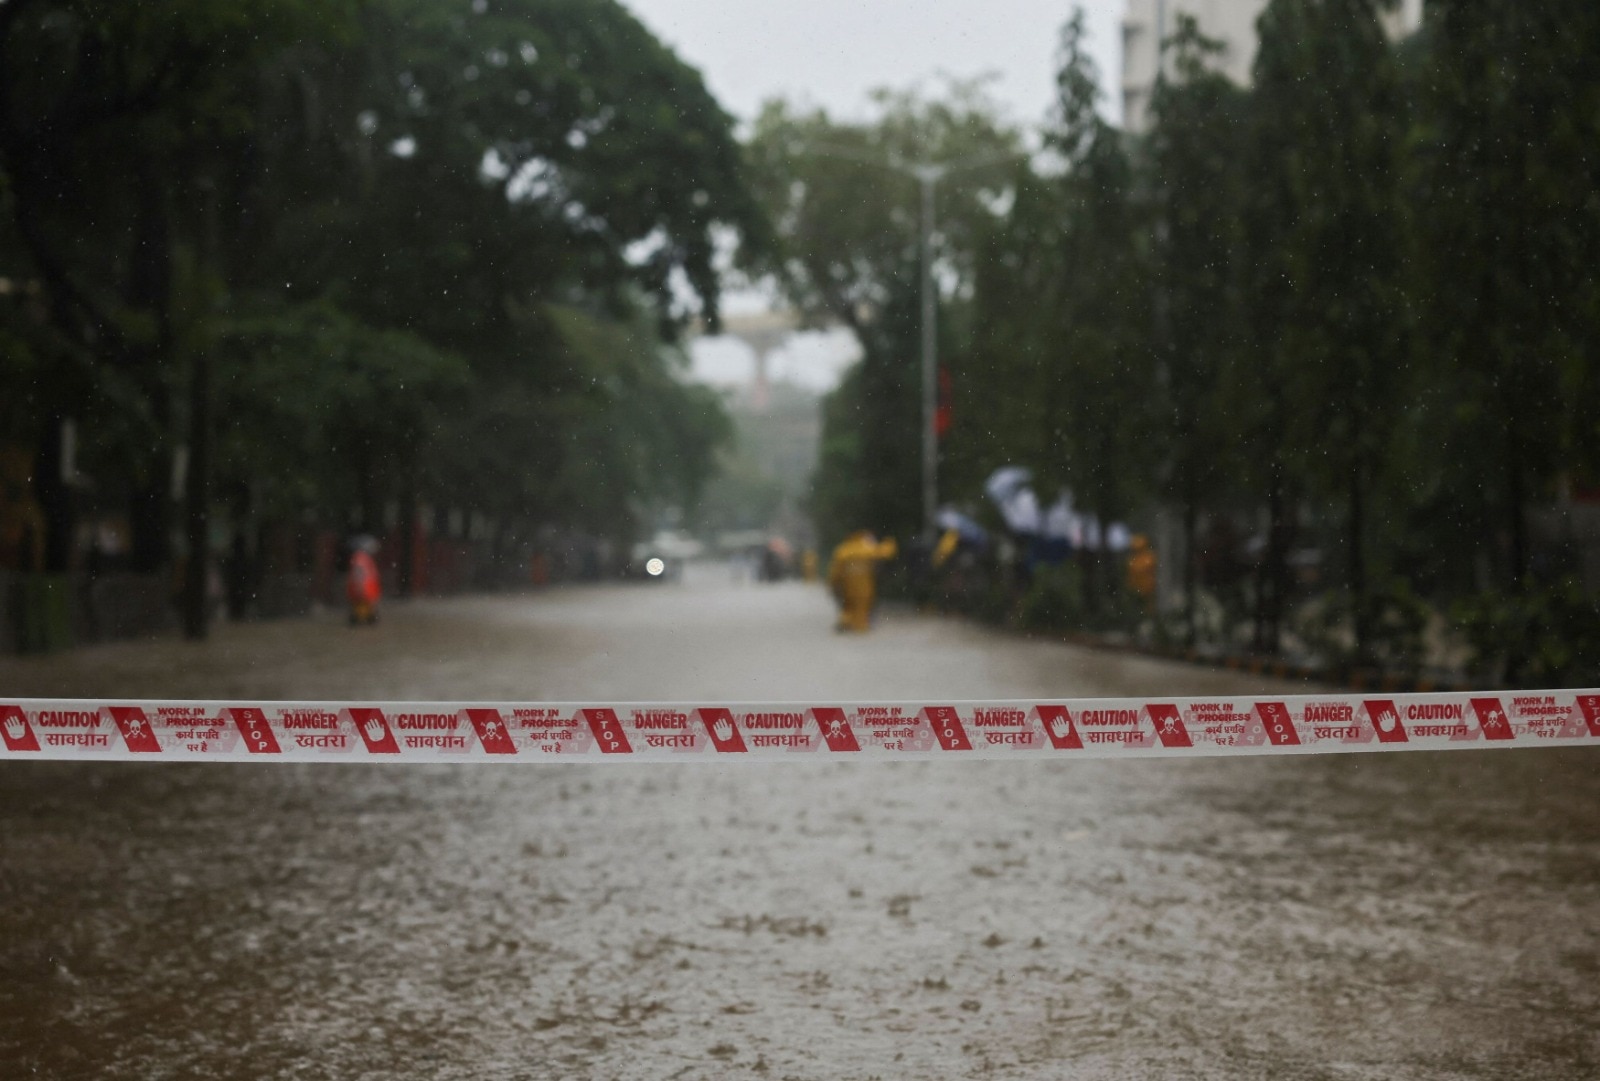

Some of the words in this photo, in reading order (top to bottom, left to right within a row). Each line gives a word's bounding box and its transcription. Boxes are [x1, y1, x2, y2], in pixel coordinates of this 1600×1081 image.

[1513, 697, 1542, 705] WORK
[1545, 696, 1555, 704] IN
[157, 707, 190, 716] WORK
[193, 708, 205, 716] IN
[513, 709, 544, 717] WORK
[548, 709, 559, 717] IN
[857, 707, 887, 716] WORK
[1190, 703, 1220, 712] WORK
[1223, 703, 1233, 711] IN
[1408, 704, 1461, 720] CAUTION
[1520, 706, 1572, 715] PROGRESS
[39, 711, 100, 728] CAUTION
[975, 711, 1025, 727] DANGER
[1082, 710, 1138, 726] CAUTION
[1198, 713, 1251, 722] PROGRESS
[1304, 706, 1353, 722] DANGER
[166, 718, 225, 726] PROGRESS
[283, 713, 338, 729] DANGER
[398, 714, 457, 729] CAUTION
[521, 719, 578, 727] PROGRESS
[635, 713, 687, 729] DANGER
[746, 713, 803, 729] CAUTION
[865, 717, 920, 726] PROGRESS
[1267, 705, 1288, 743] STOP
[176, 729, 193, 739] कार्य
[243, 710, 268, 751] STOP
[595, 711, 619, 751] STOP
[873, 728, 889, 738] कार्य
[937, 709, 959, 748] STOP
[1205, 725, 1221, 734] कार्य
[1313, 726, 1361, 739] खतरा
[1413, 725, 1468, 736] सावधान
[45, 733, 109, 746] सावधान
[294, 734, 347, 748] खतरा
[530, 730, 548, 740] कार्य
[645, 734, 696, 747] खतरा
[752, 734, 810, 747] सावधान
[984, 732, 1034, 744] खतरा
[1088, 731, 1145, 743] सावधान
[1216, 737, 1226, 746] पर
[1228, 734, 1234, 746] है
[201, 741, 208, 752] है
[404, 735, 465, 748] सावधान
[555, 742, 561, 753] है
[884, 742, 895, 750] पर
[897, 739, 903, 750] है
